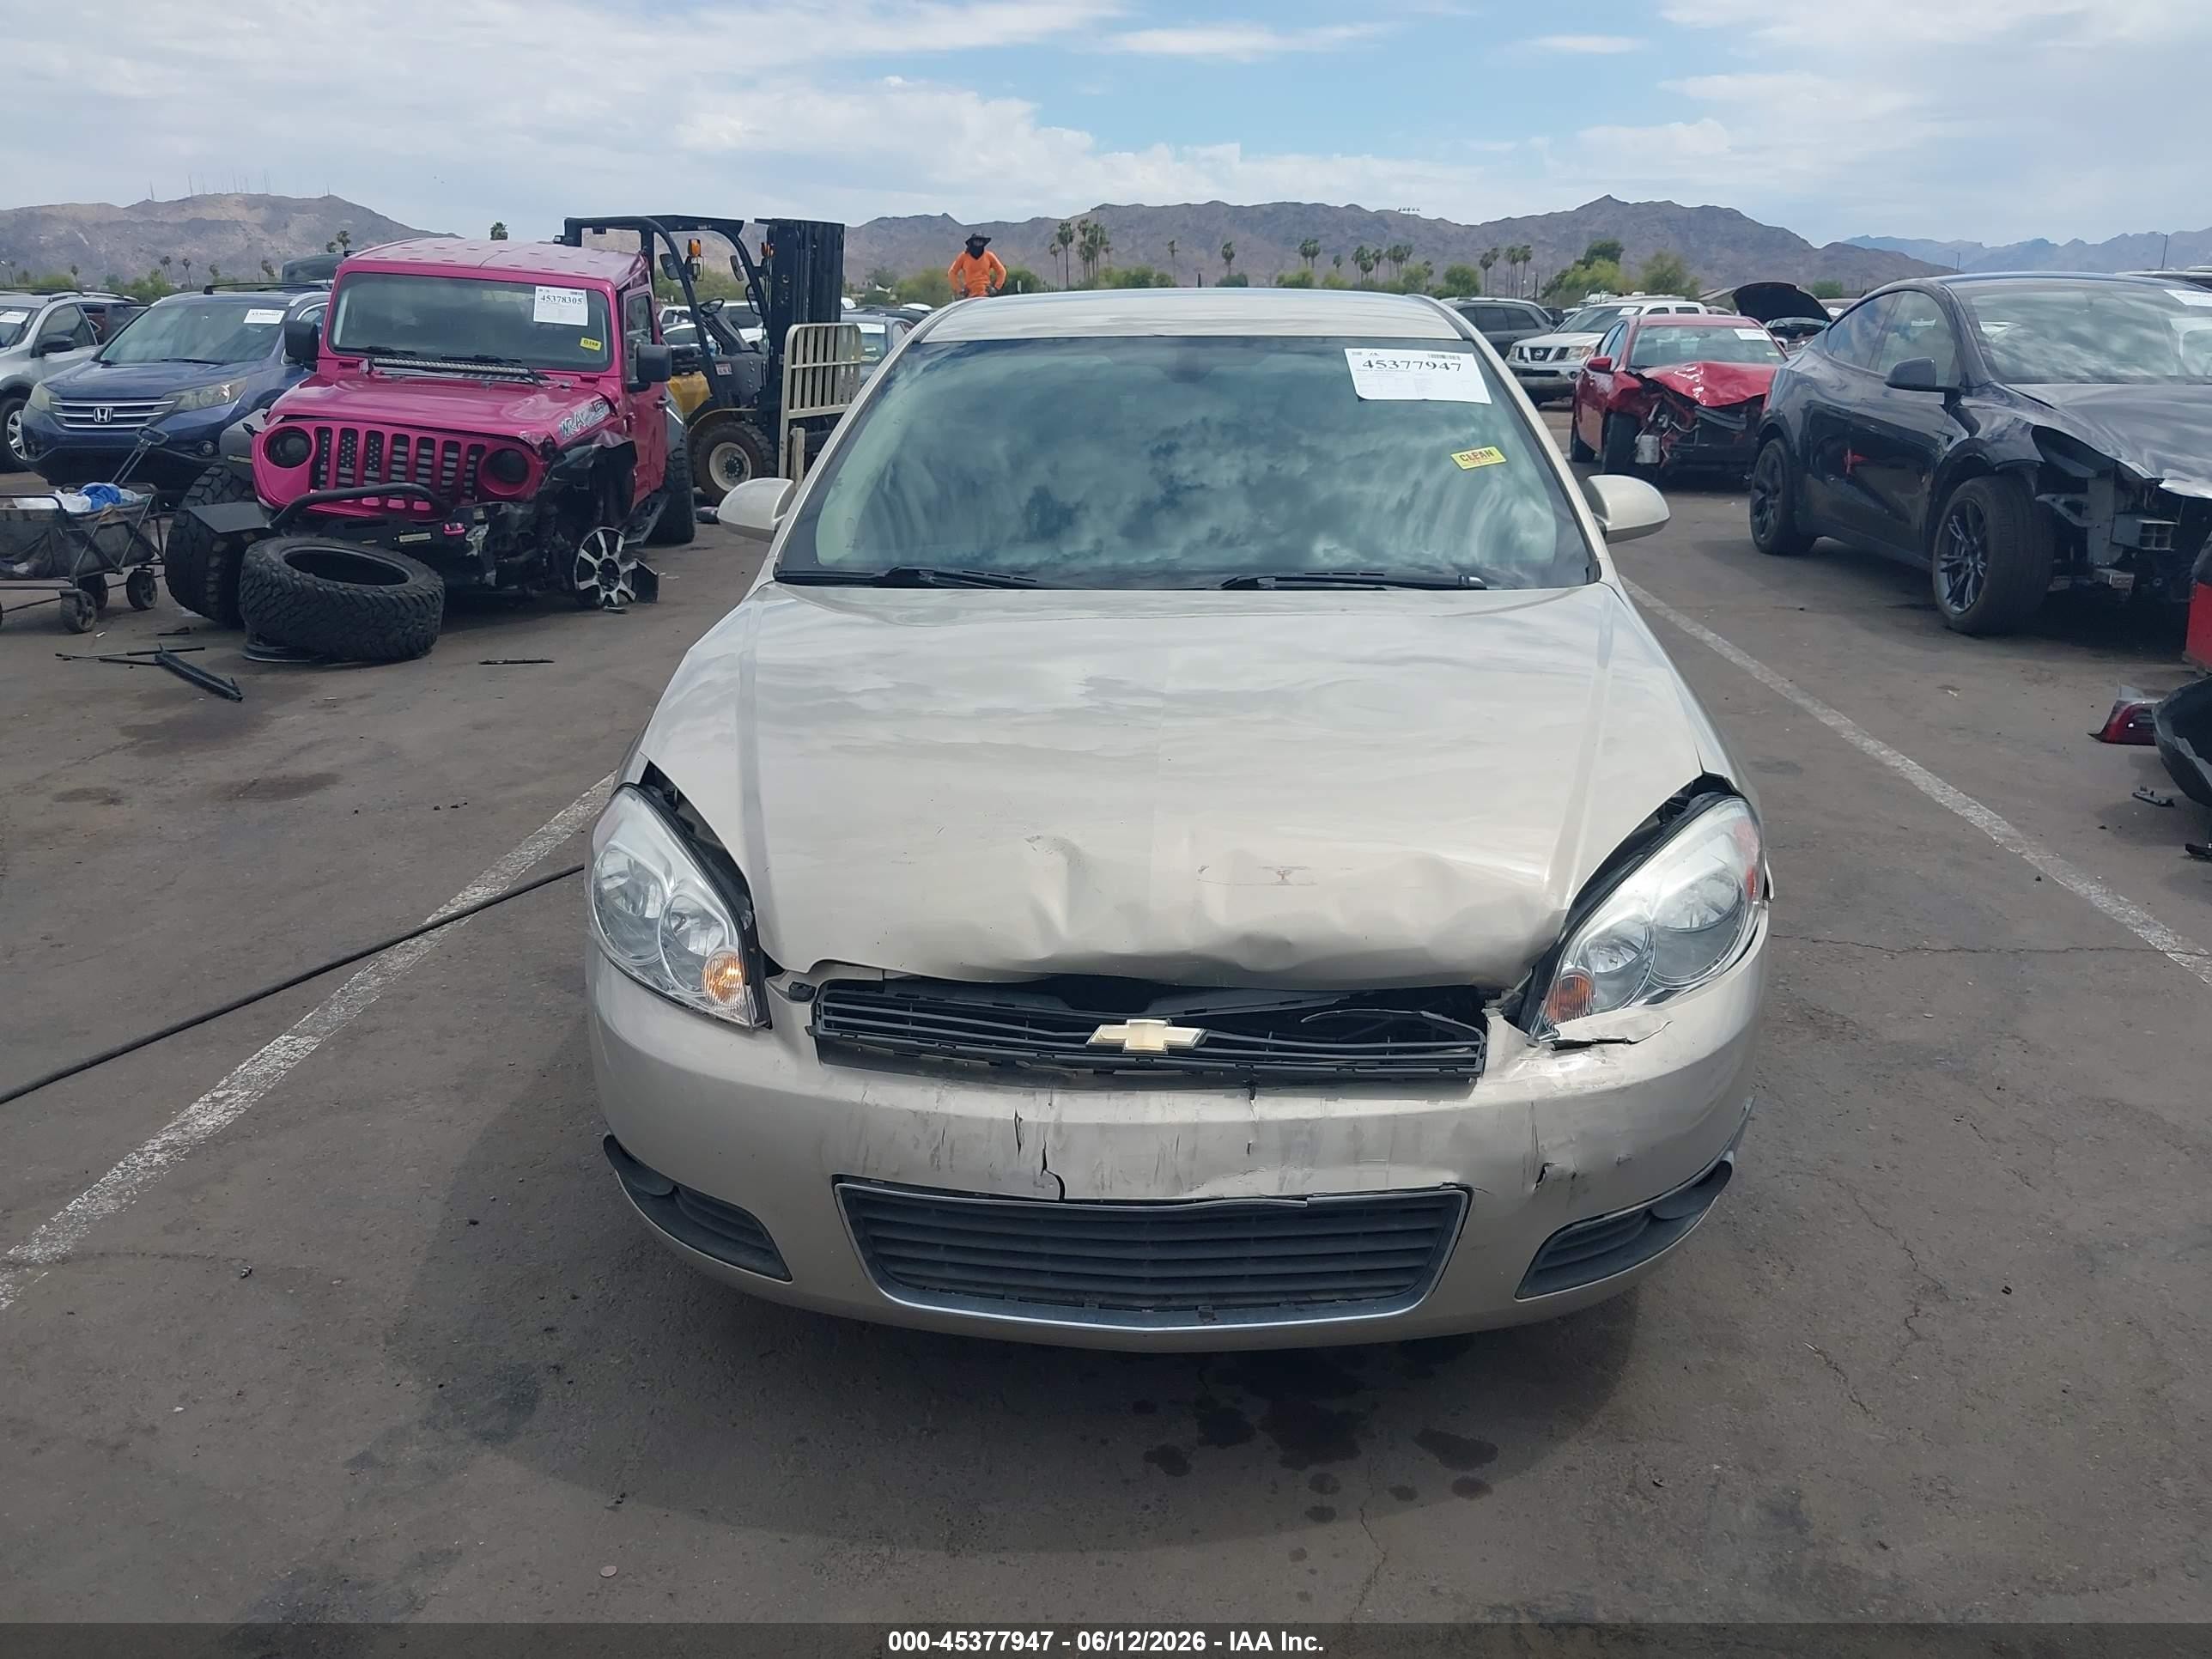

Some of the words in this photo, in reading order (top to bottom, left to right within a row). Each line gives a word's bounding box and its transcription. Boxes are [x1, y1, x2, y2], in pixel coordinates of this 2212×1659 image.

[541, 295, 583, 305] 45378305
[1363, 360, 1462, 372] 45377947
[1459, 449, 1494, 462] CLEAN
